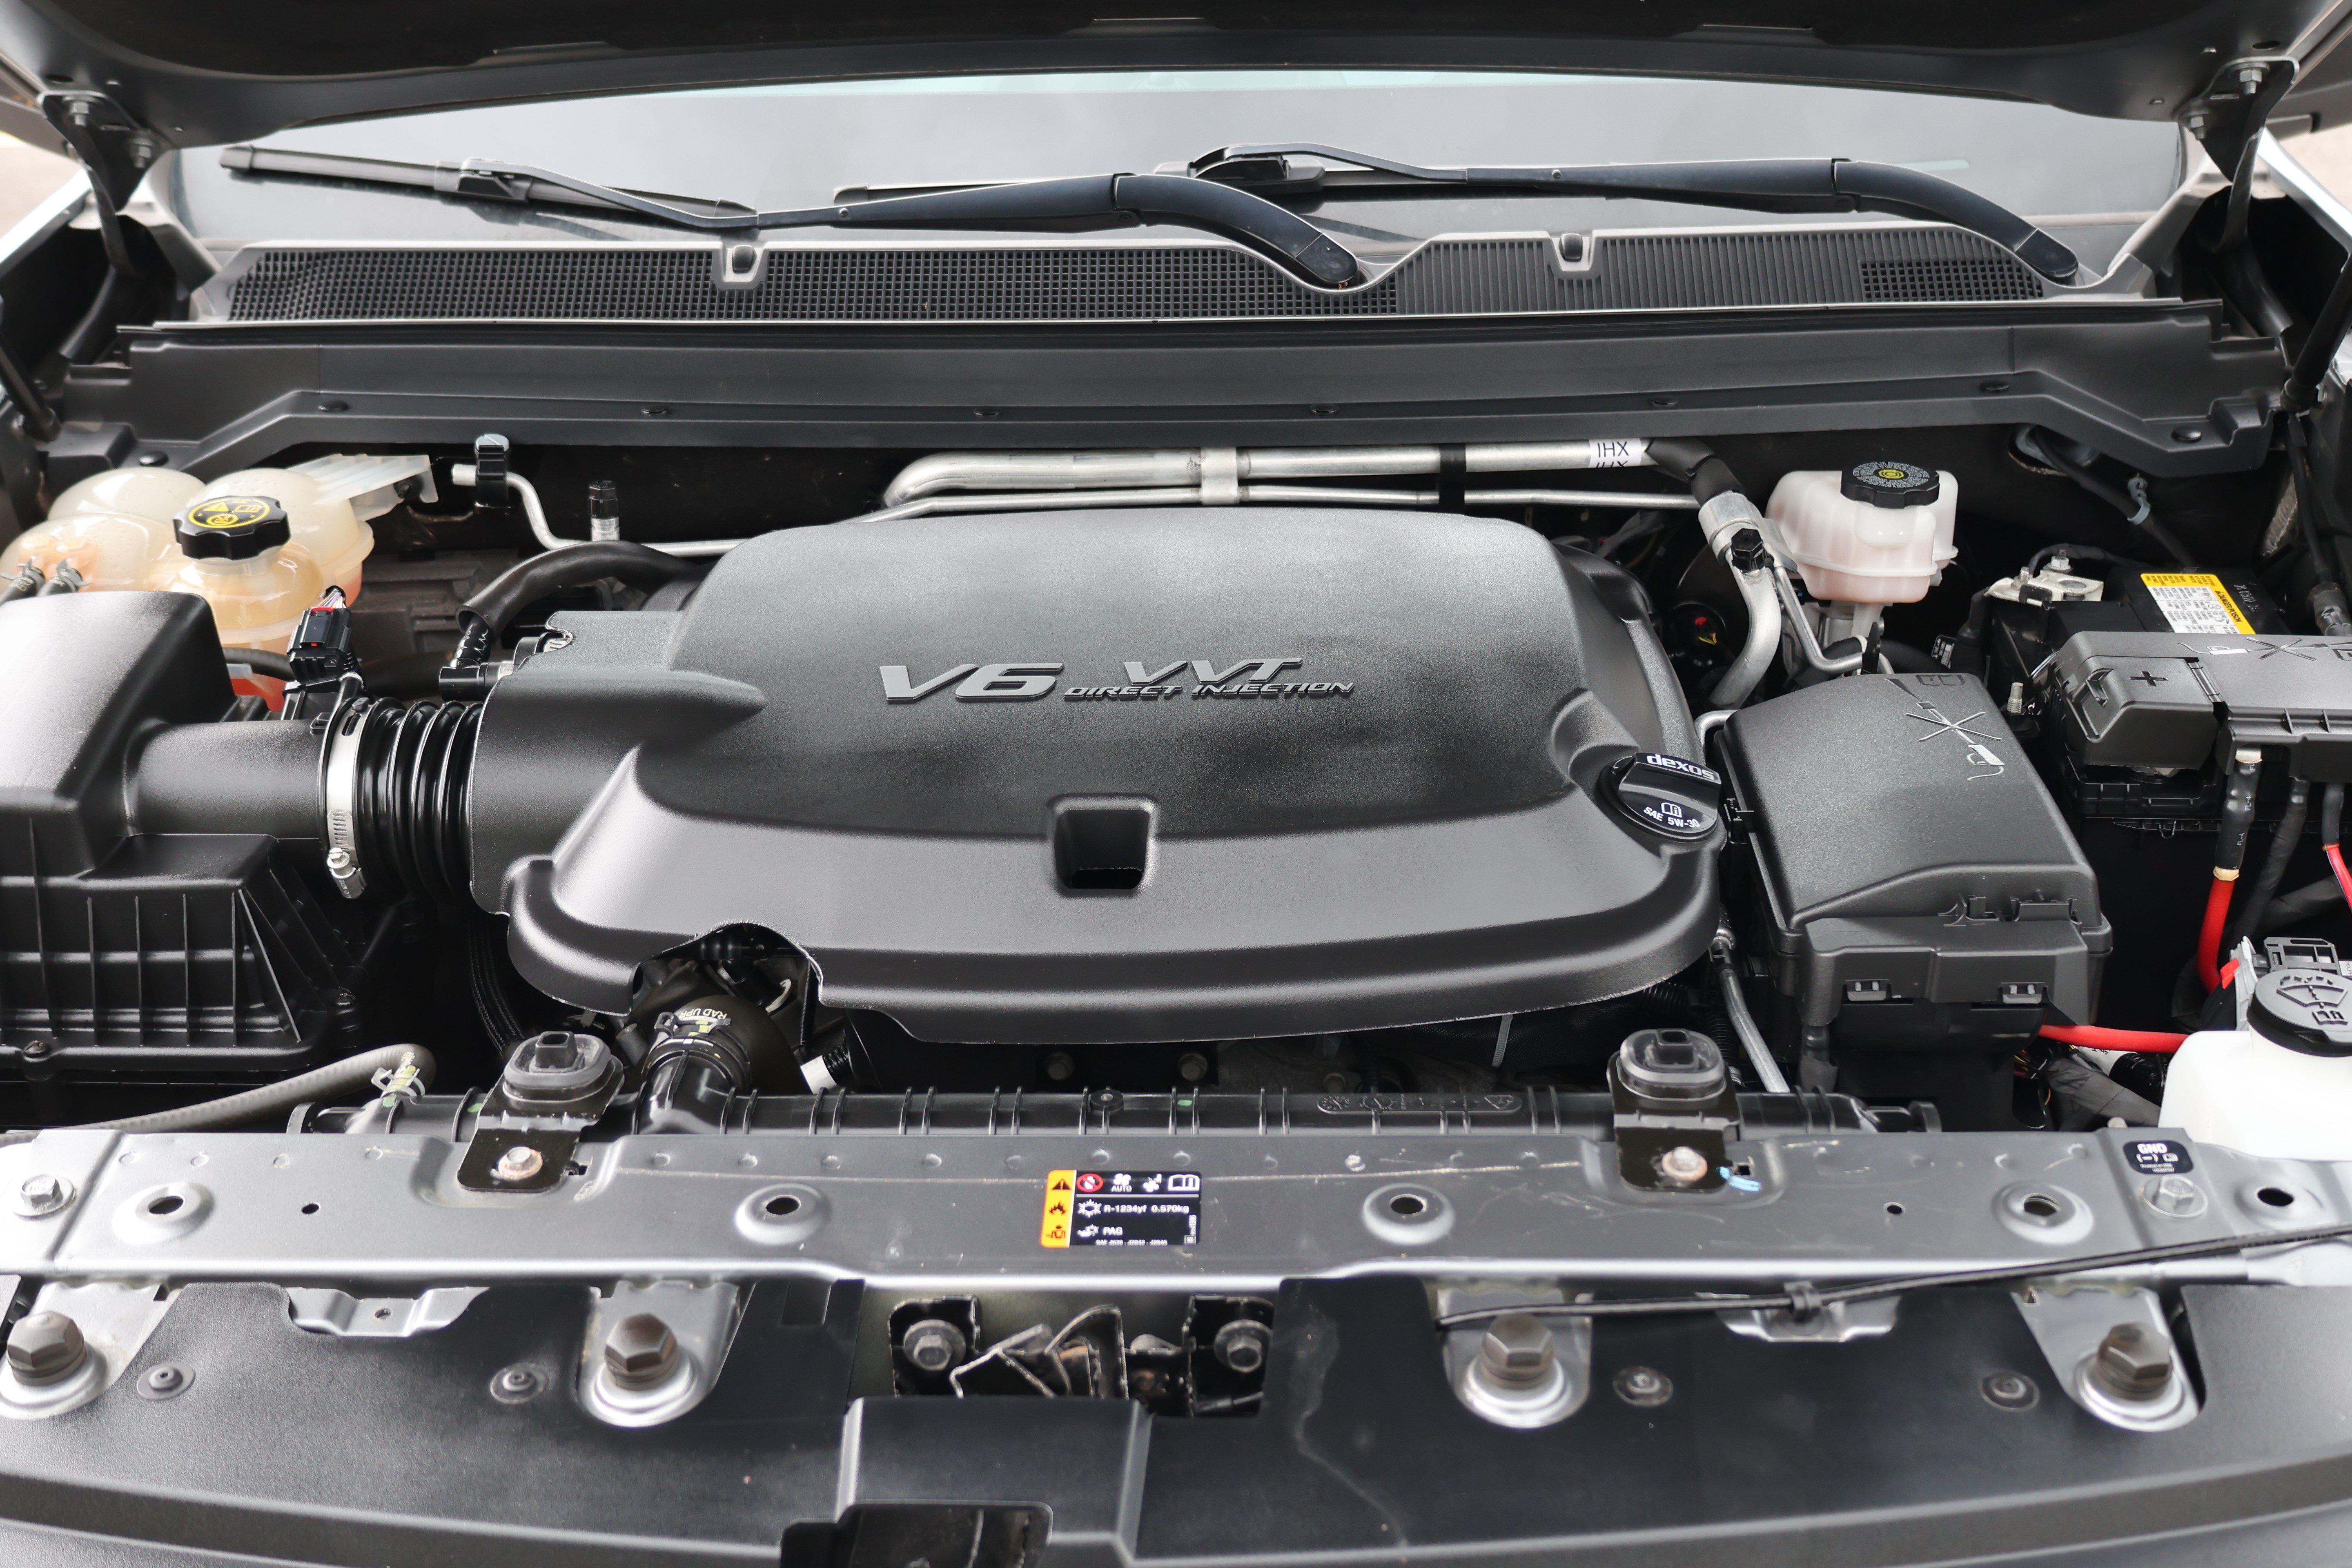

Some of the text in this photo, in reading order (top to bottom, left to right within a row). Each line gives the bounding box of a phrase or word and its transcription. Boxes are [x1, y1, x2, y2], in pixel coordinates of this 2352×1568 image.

[1597, 441, 1629, 458] IHX
[879, 658, 1304, 703] V6 VVT
[1063, 682, 1355, 701] DIRECT INJECTION
[1646, 754, 1715, 780] dexos
[1643, 806, 1700, 828] SAE 5W-30
[2237, 833, 2245, 845] FL-4
[679, 1008, 728, 1019] RAD UPR
[2137, 1143, 2167, 1154] GND
[1103, 1205, 1189, 1214] R-1234yf 0.570kg
[1103, 1227, 1123, 1236] PAG
